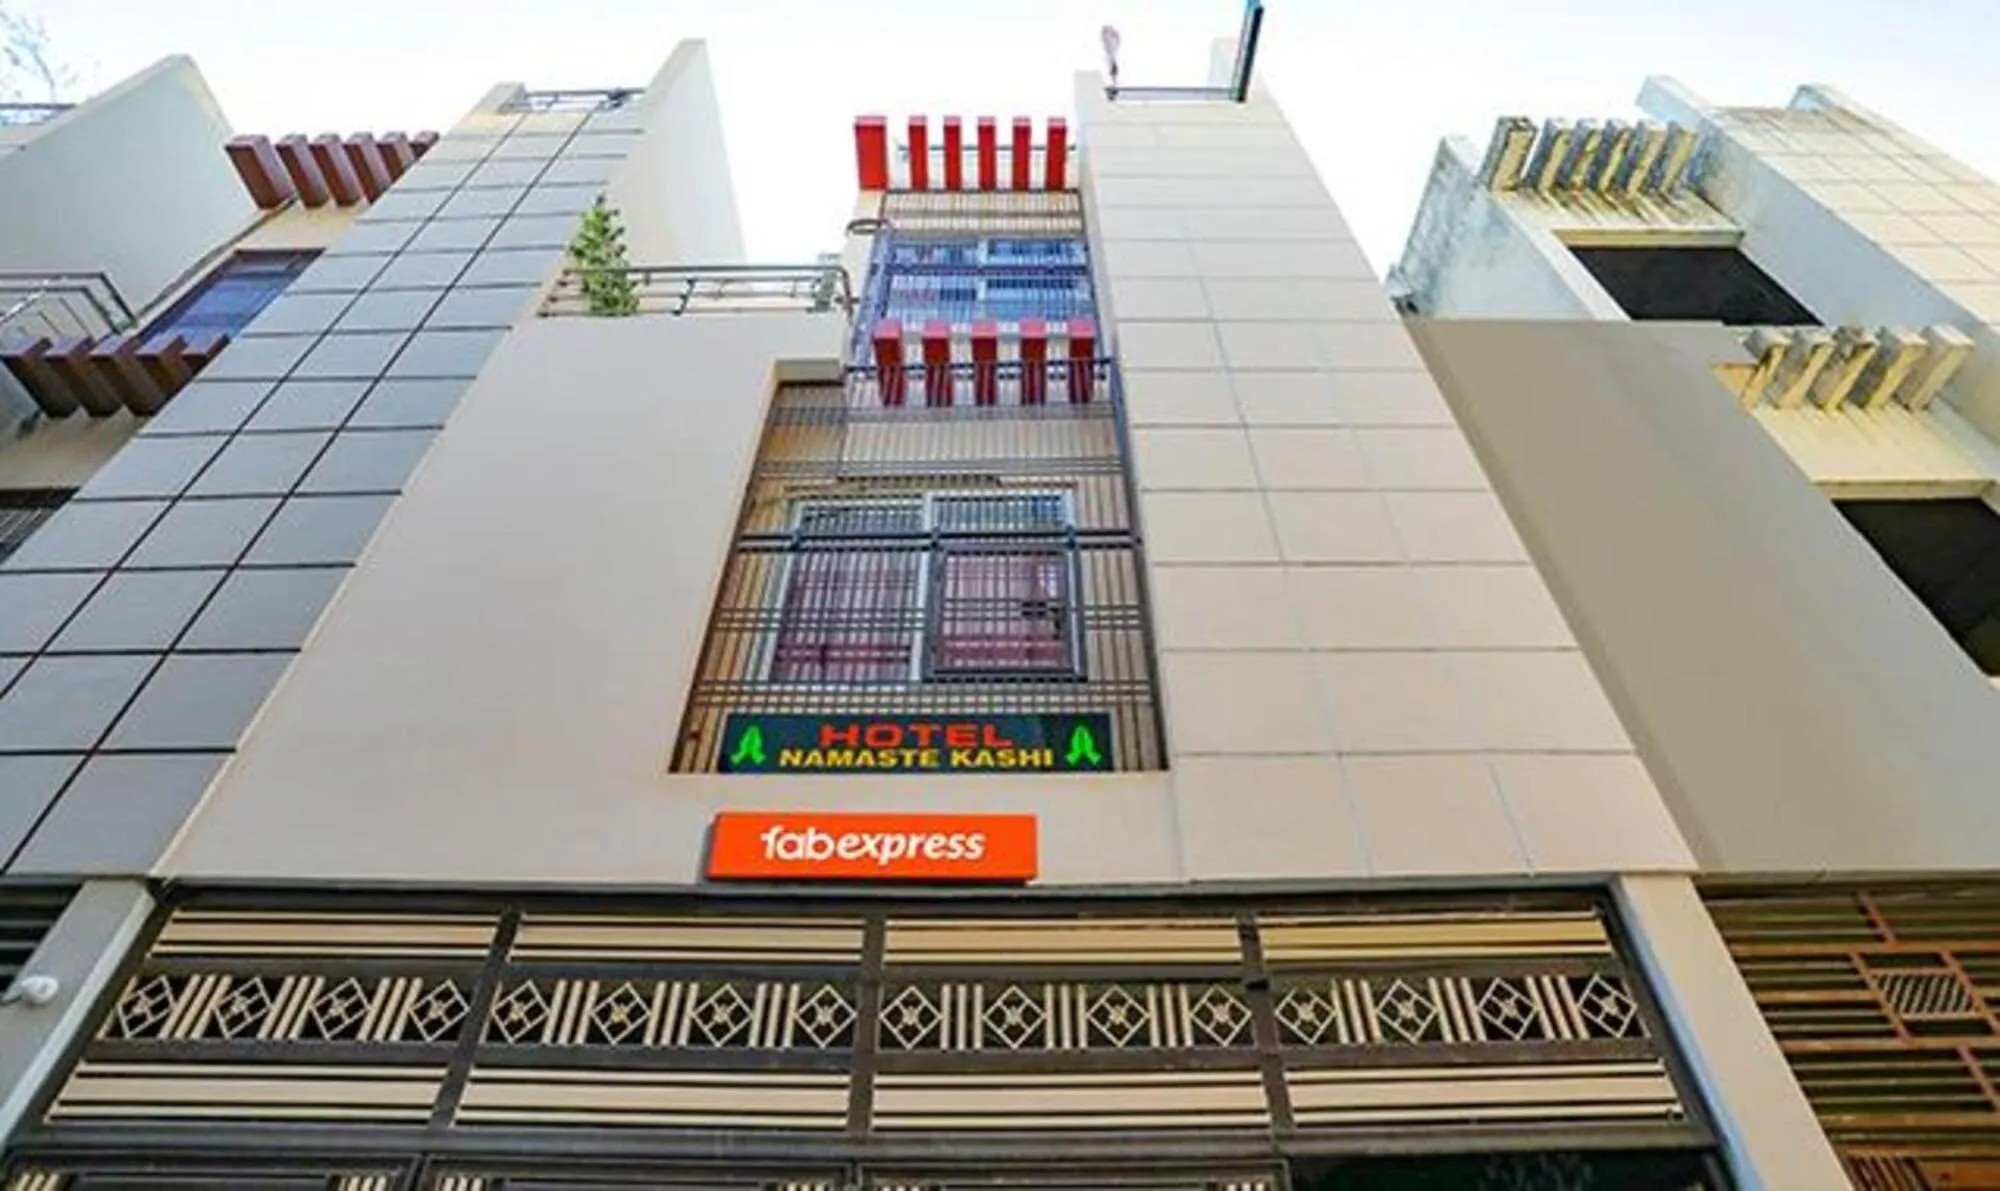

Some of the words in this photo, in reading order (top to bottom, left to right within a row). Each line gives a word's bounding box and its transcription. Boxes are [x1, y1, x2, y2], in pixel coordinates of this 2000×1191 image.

[820, 723, 1012, 748] HOTEL
[779, 748, 940, 767] NAMASTE
[950, 748, 1054, 767] KASHI
[761, 825, 985, 865] fabexpress
